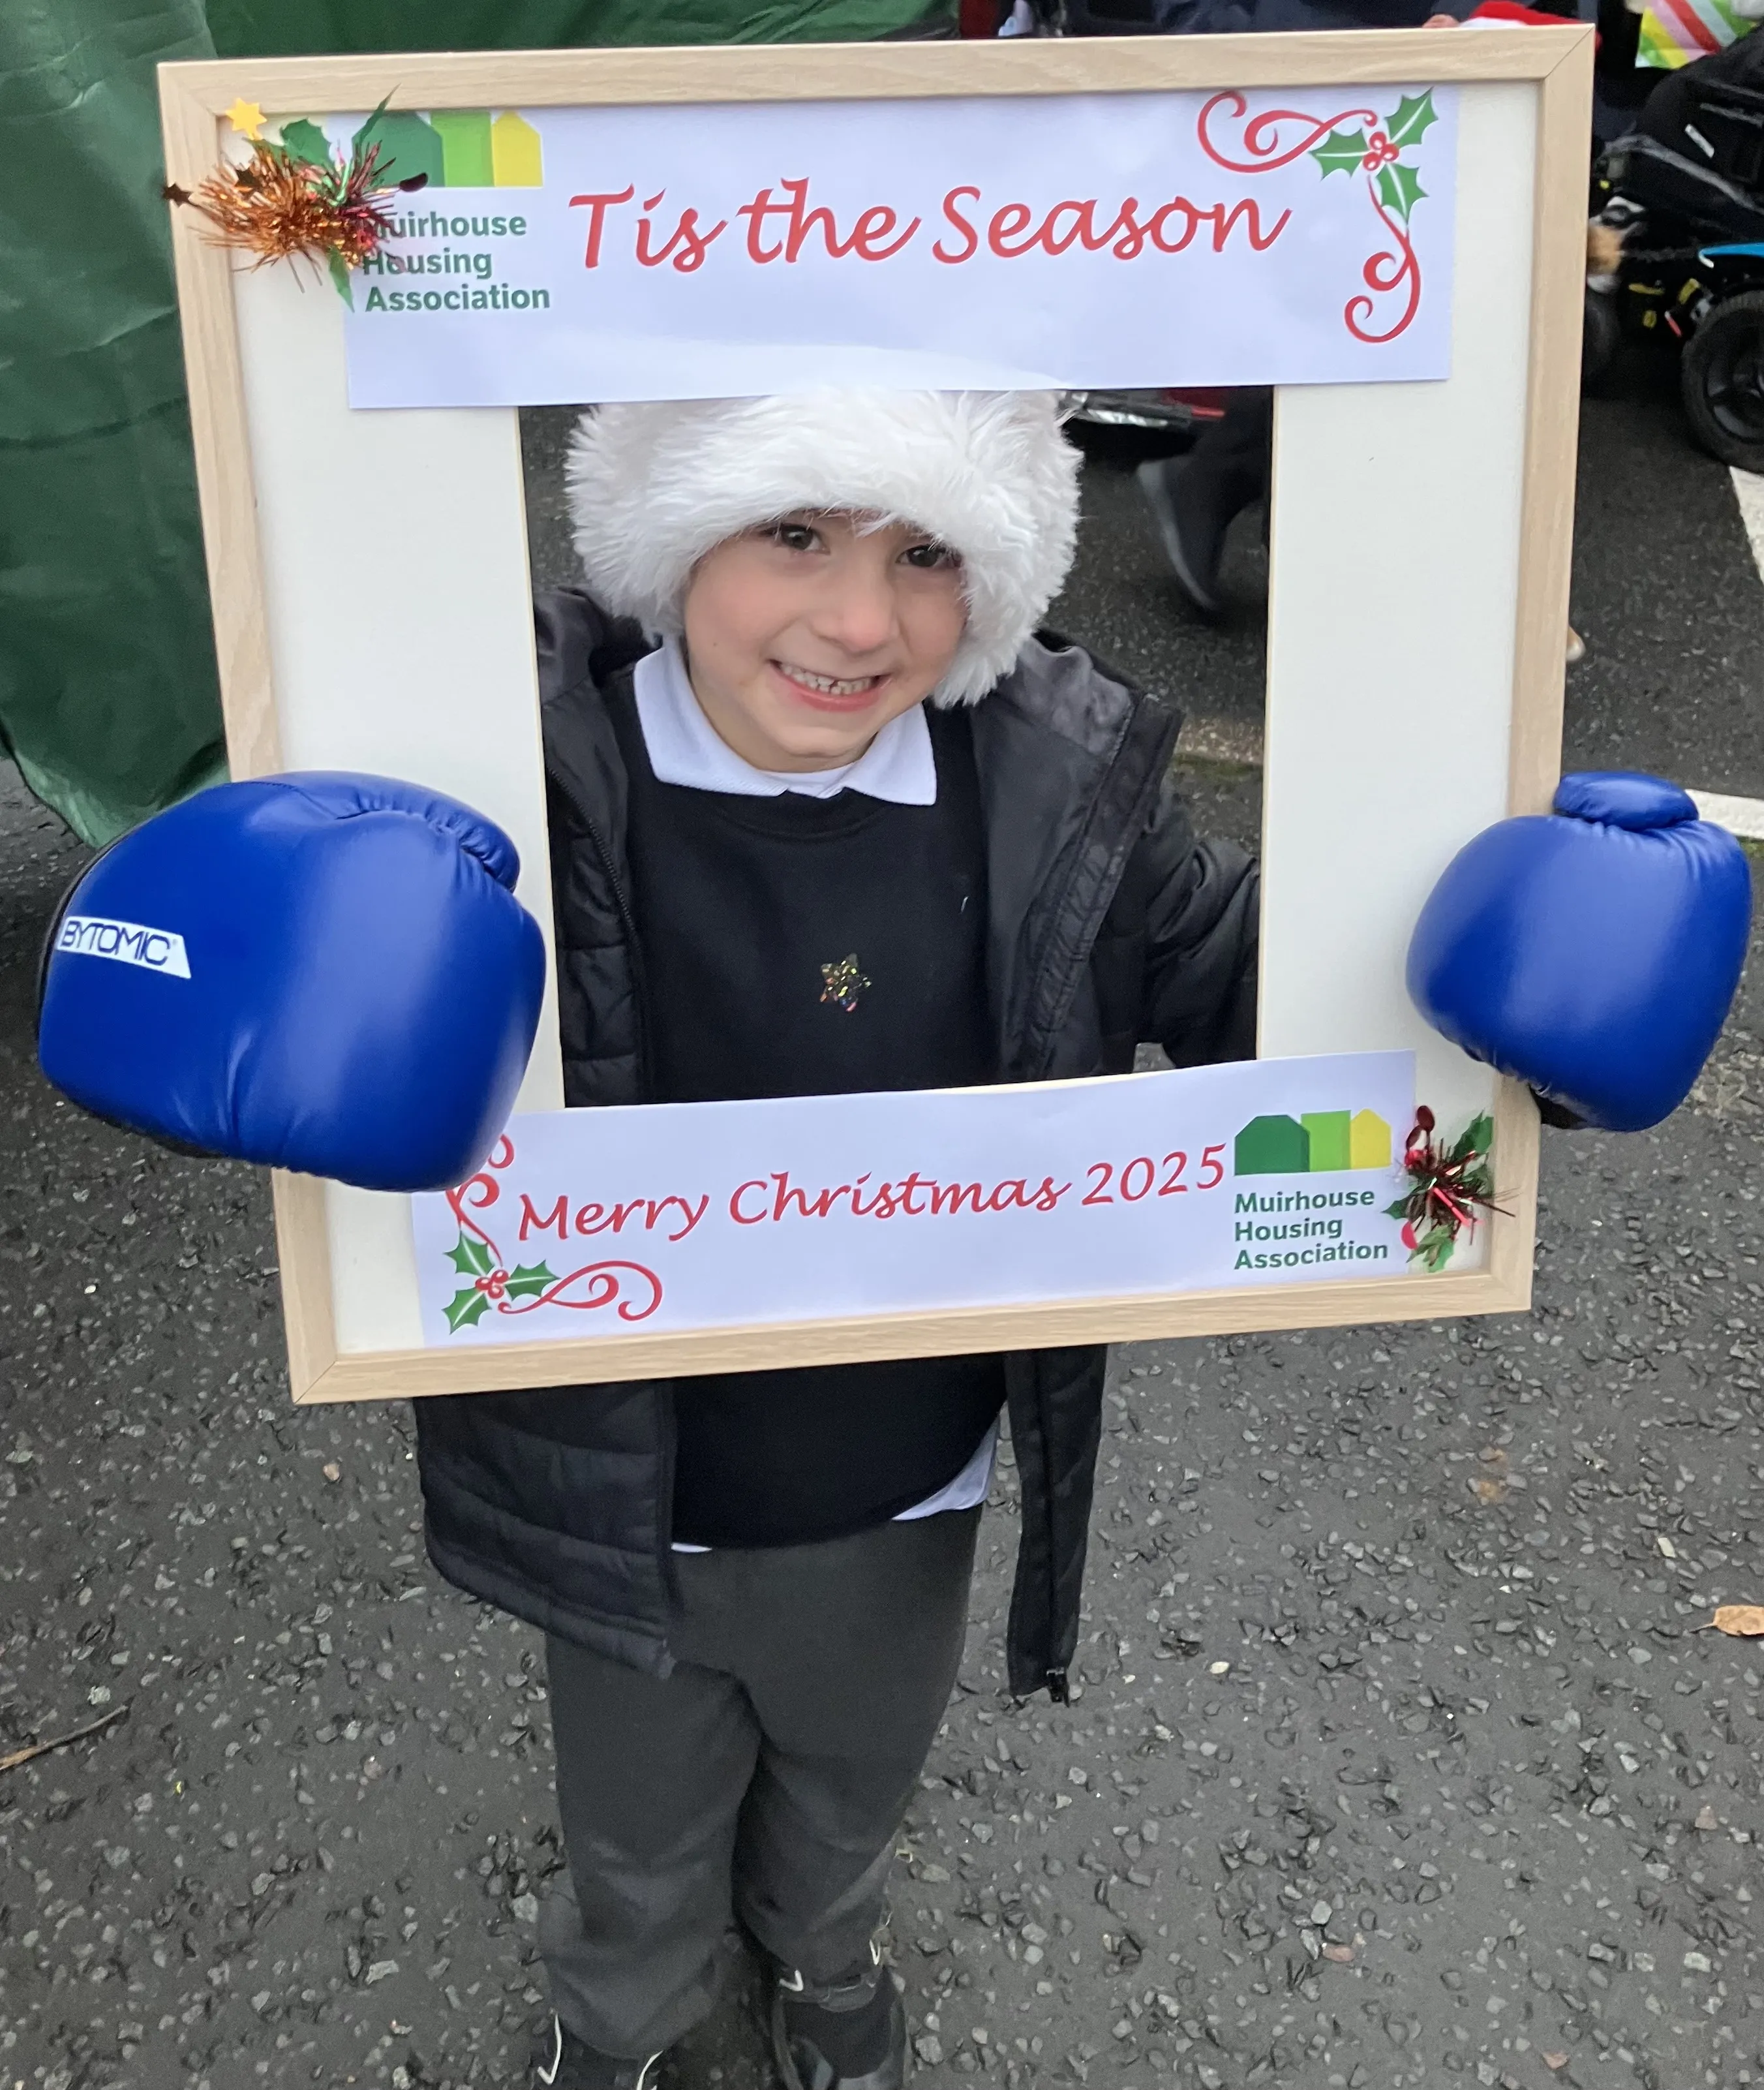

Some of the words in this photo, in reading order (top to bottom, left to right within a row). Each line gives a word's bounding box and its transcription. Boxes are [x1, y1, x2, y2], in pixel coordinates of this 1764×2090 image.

[569, 184, 727, 273] Tis
[738, 177, 921, 264] the
[932, 185, 1292, 265] Season
[363, 246, 493, 280] Housing
[365, 283, 550, 312] Association
[61, 920, 171, 966] BYTOMIC
[518, 1193, 710, 1242] Merry
[729, 1171, 1072, 1225] Christmas
[1081, 1143, 1226, 1206] 2025
[1234, 1189, 1375, 1214] Muirhouse
[1234, 1217, 1343, 1241] Housing
[1234, 1240, 1388, 1270] Association
